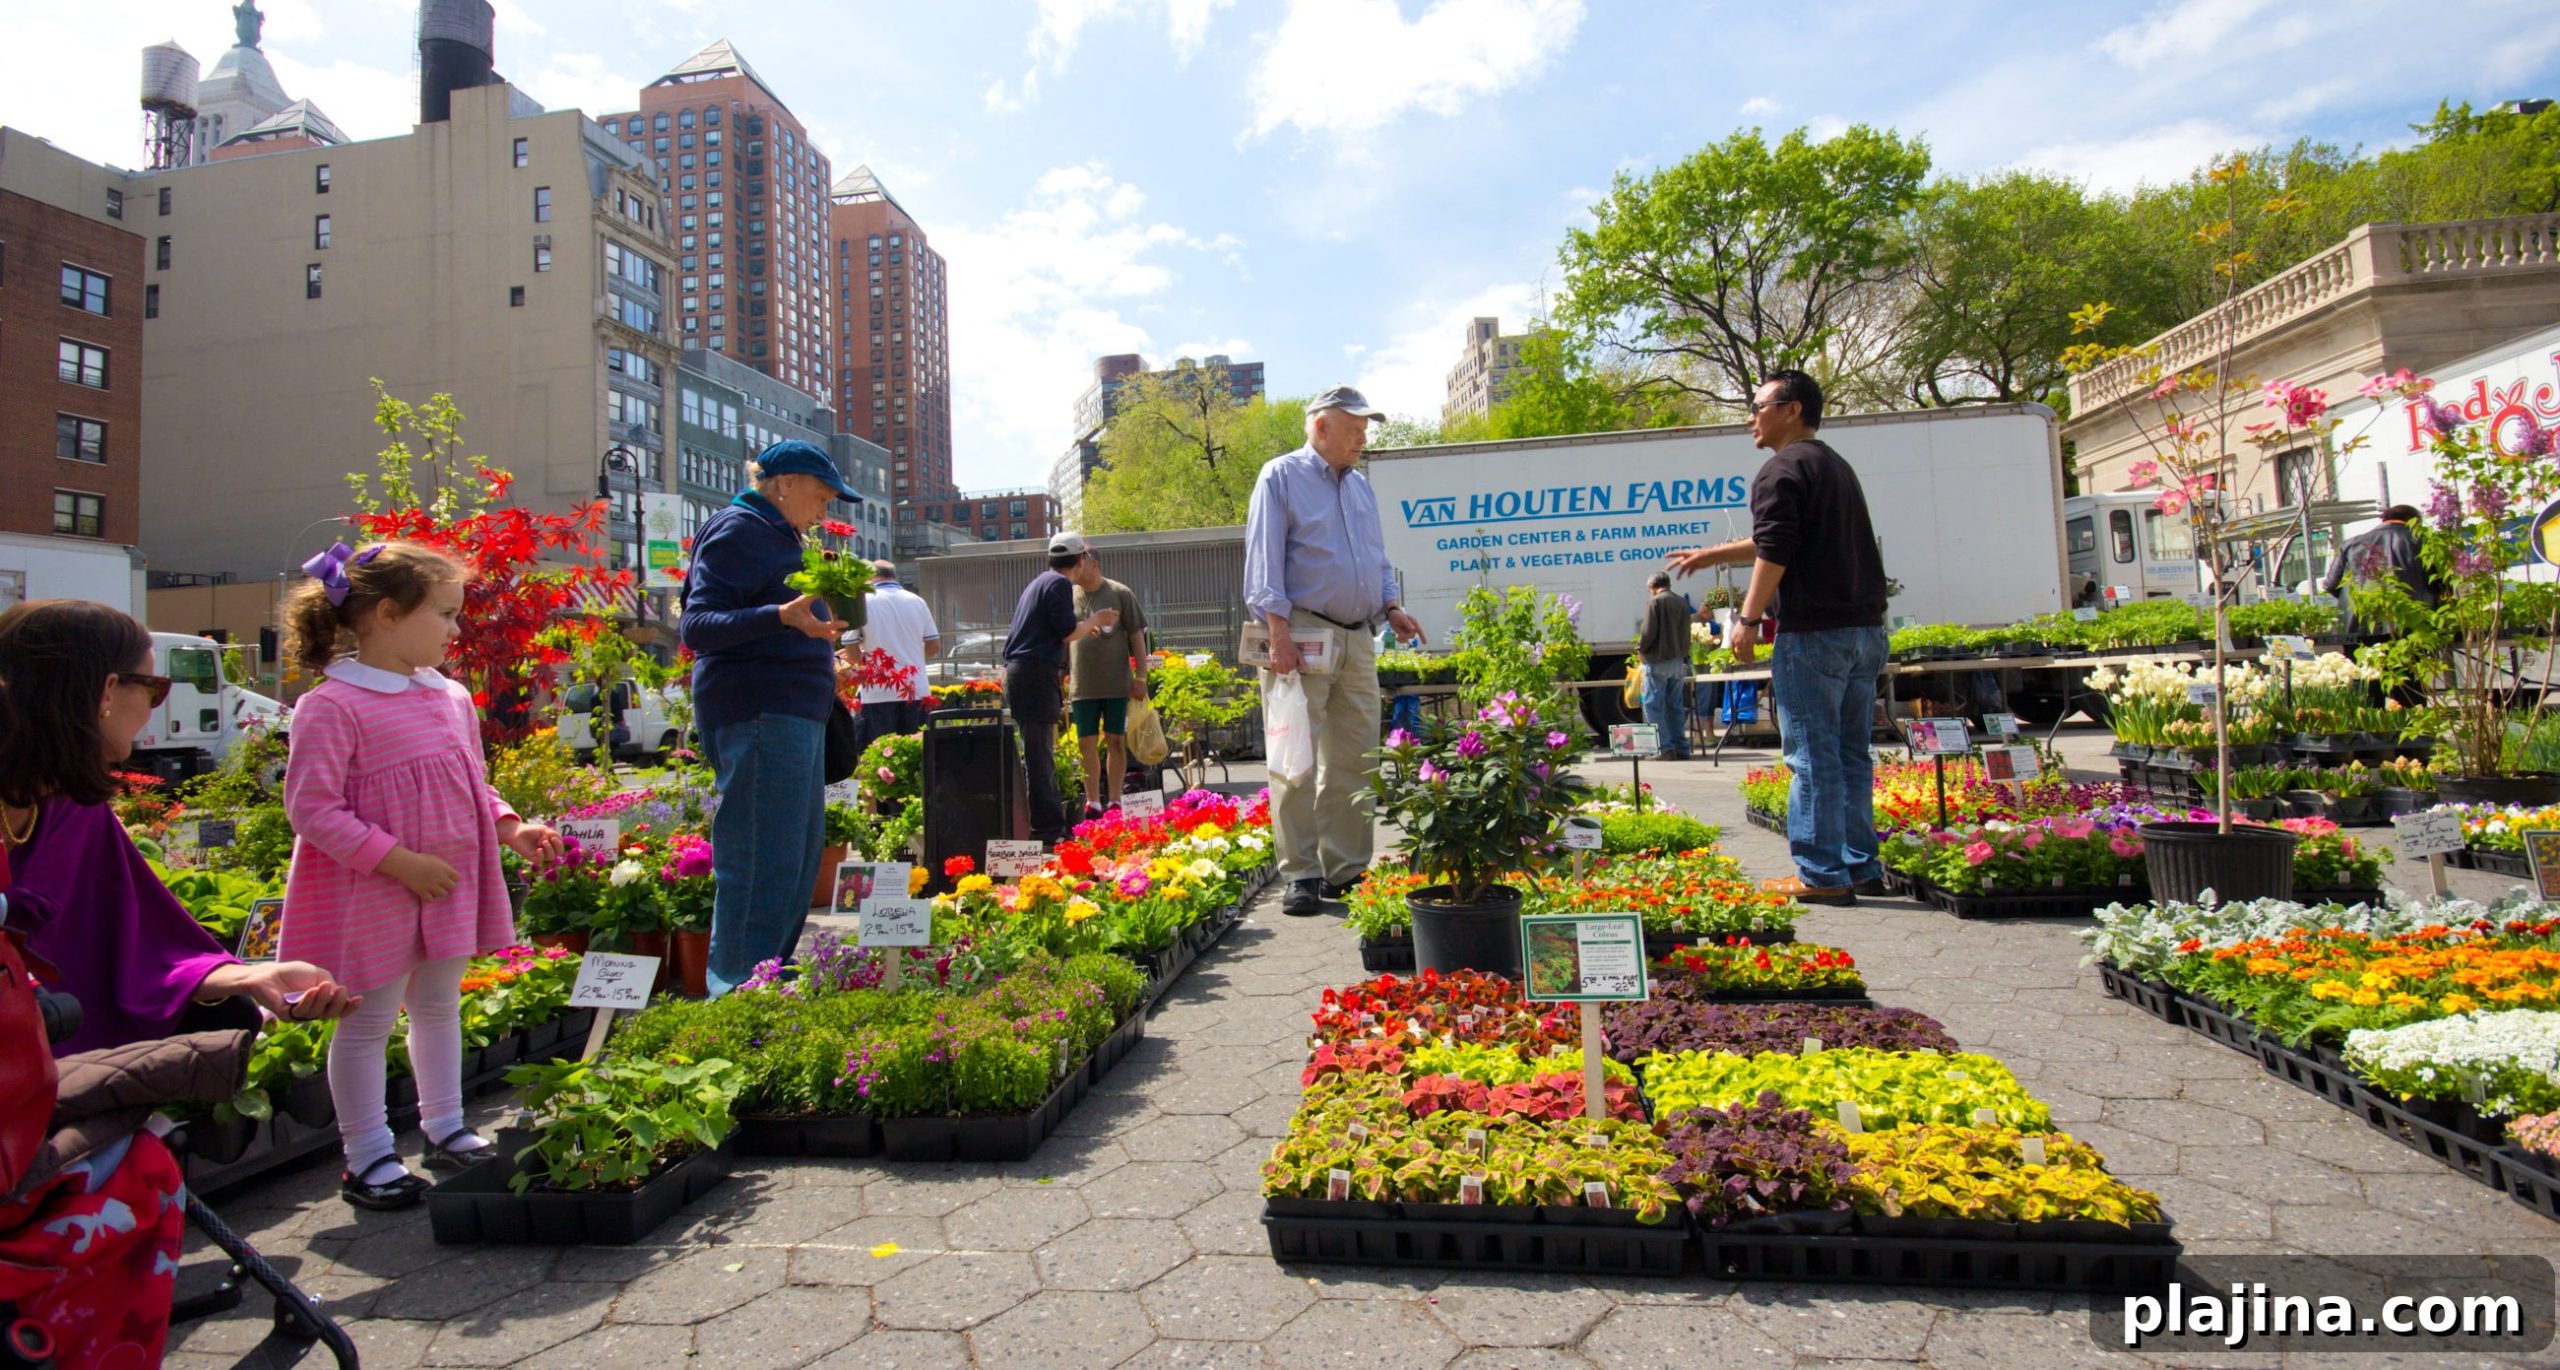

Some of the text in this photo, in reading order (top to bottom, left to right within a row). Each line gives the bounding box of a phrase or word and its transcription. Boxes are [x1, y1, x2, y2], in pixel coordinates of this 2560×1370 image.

[1401, 475, 1747, 524] VAN HOUTEN FARMS
[1437, 521, 1710, 551] GARDEN CENTER & FARM MARKET
[1450, 545, 1703, 572] PLANT & VEGETABLE GROW
